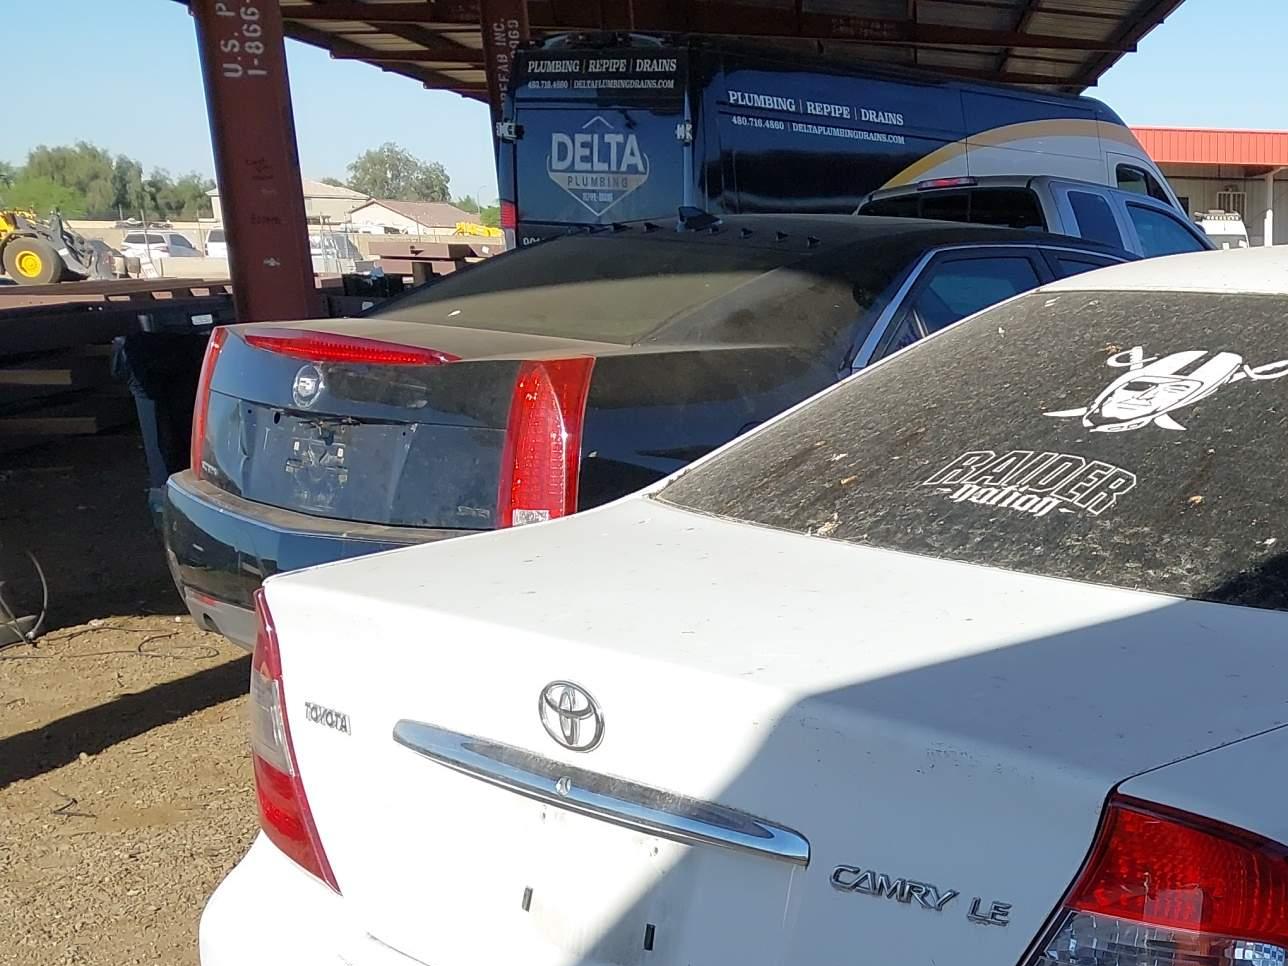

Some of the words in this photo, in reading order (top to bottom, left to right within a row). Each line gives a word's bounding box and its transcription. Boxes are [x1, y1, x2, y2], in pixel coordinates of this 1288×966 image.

[493, 18, 507, 47] INC.
[528, 60, 580, 73] PLUMBING
[588, 59, 627, 72] REPIPE
[636, 58, 677, 72] DRAINS
[728, 91, 796, 112] PLUMBING
[806, 101, 851, 119] REPIPE
[861, 108, 904, 126] DRAINS
[792, 122, 905, 145] DELTAPLUMBINGDRAINS.COM
[551, 133, 646, 173] DELTA
[567, 175, 628, 189] PLUMBING
[922, 450, 1137, 516] RAIDER
[304, 701, 352, 737] TOYOTA
[829, 864, 960, 912] CAMRY
[967, 896, 1013, 927] LE
